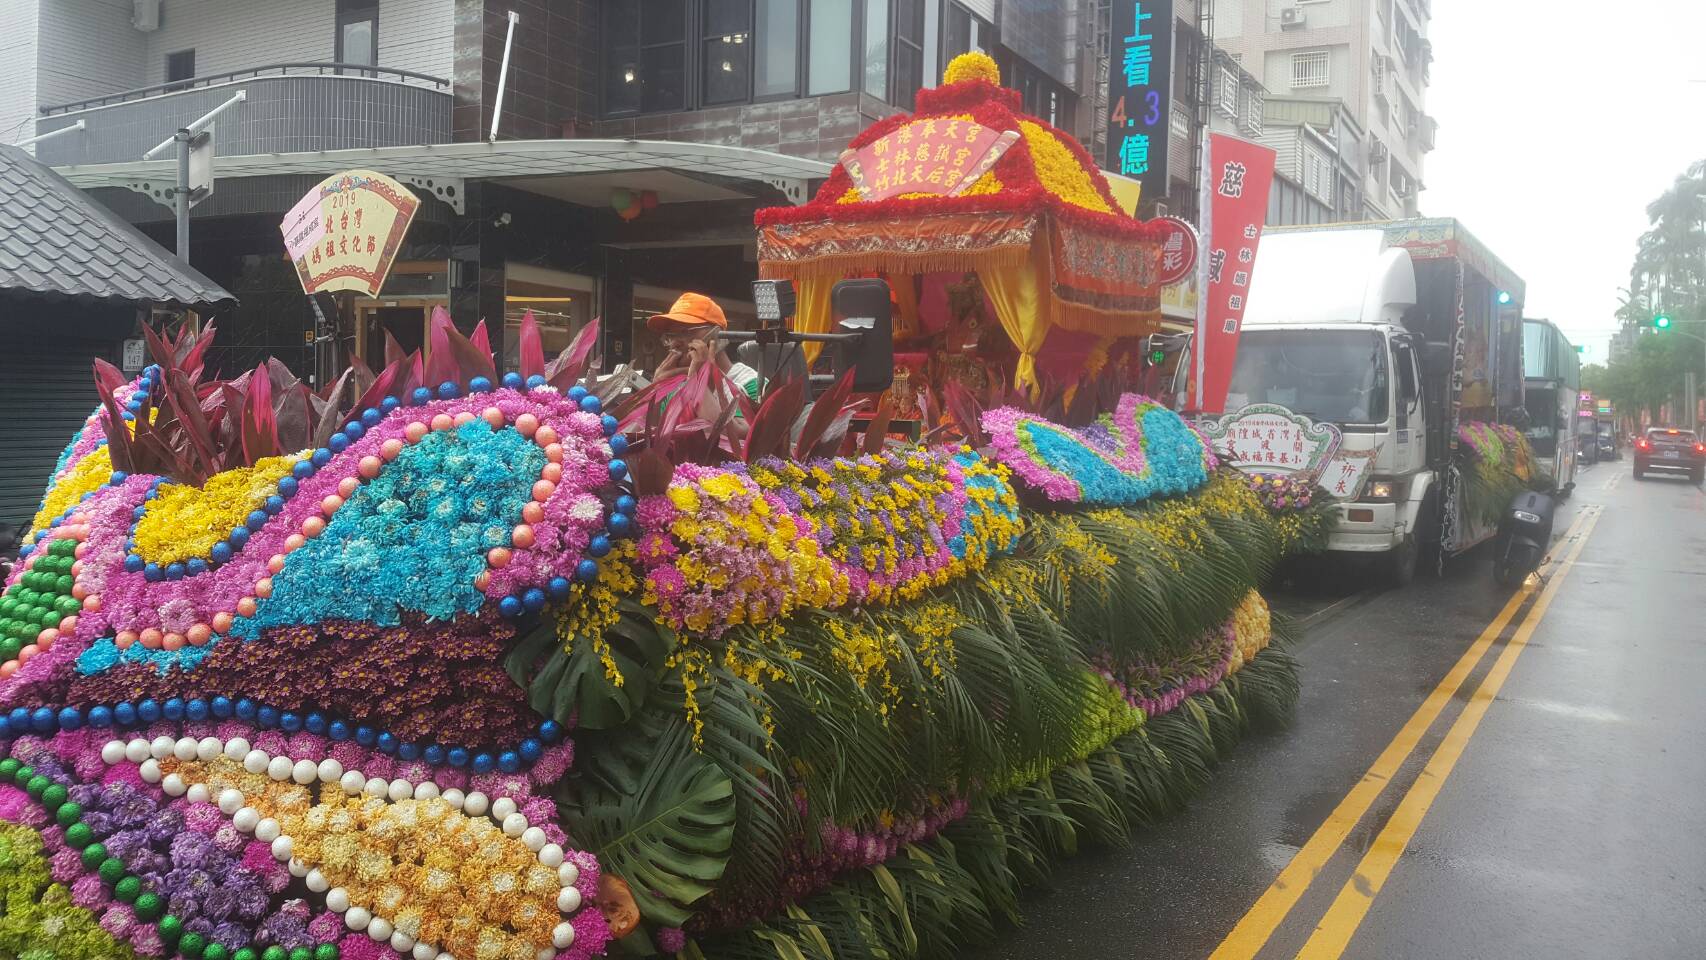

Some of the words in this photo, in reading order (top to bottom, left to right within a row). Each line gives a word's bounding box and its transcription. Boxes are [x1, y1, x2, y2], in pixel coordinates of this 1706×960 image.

[874, 121, 982, 156] 新港奉天宮
[875, 164, 963, 191] 竹北天后宮
[332, 192, 356, 209] 2019
[325, 208, 363, 233] 北台灣
[311, 234, 376, 265] 媽祖文化節
[1223, 224, 1257, 334] 士林媽祖廟
